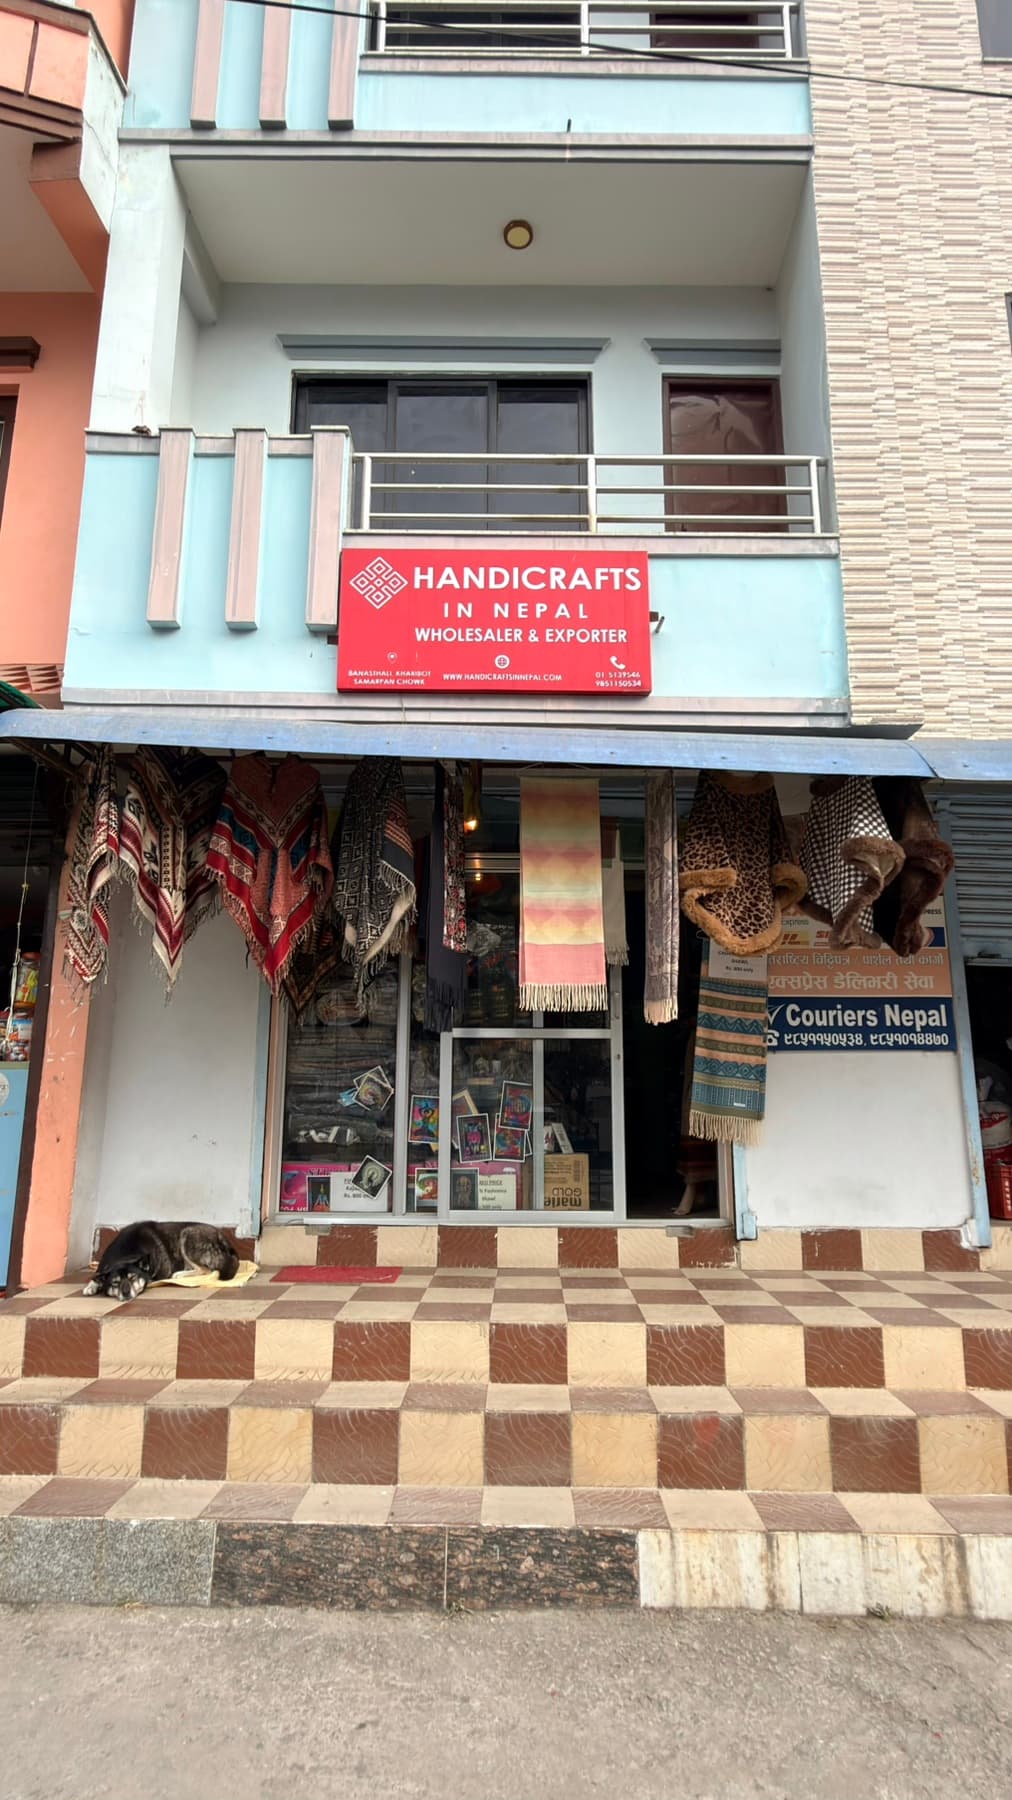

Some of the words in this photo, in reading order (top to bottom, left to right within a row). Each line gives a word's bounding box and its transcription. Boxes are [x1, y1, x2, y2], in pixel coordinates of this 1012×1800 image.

[413, 566, 642, 591] HANDICRAFTS
[443, 602, 473, 619] IN
[494, 602, 588, 619] NEPAL
[414, 627, 523, 643] WHOLESALER
[528, 629, 539, 643] &
[545, 628, 628, 643] EXPORTER
[396, 678, 426, 686] CHOWK
[442, 672, 562, 682] WWW.HANDICRAFTSINNEPAL.COM
[833, 971, 898, 991] डेलिभरी
[903, 971, 935, 991] सेवा
[786, 1004, 878, 1028] Couriers
[884, 1003, 947, 1032] Nepal
[551, 1187, 582, 1197] GOLD
[544, 1196, 582, 1208] marie
